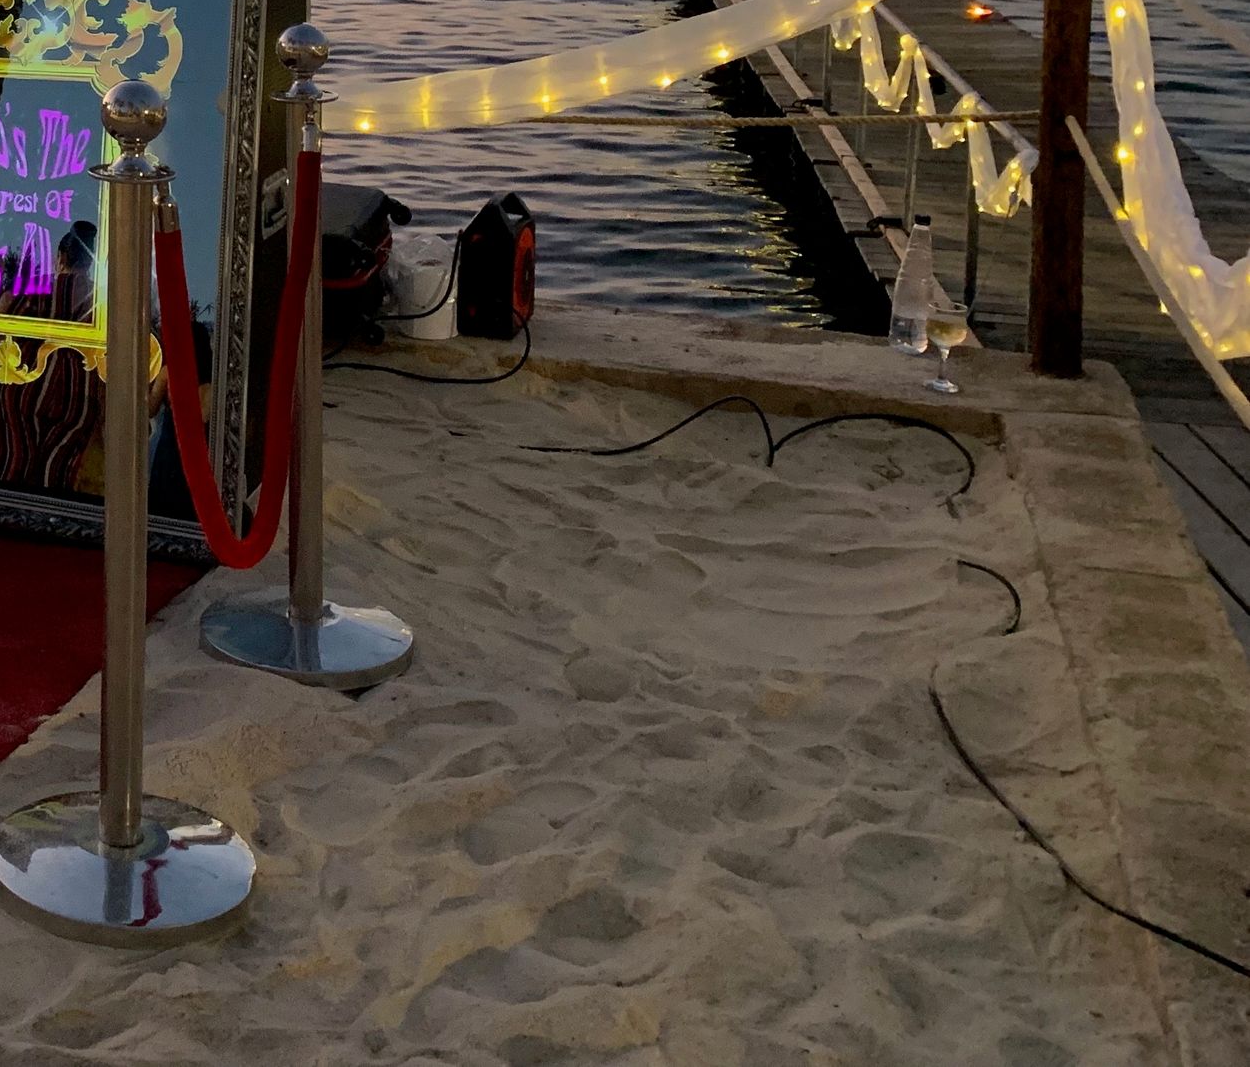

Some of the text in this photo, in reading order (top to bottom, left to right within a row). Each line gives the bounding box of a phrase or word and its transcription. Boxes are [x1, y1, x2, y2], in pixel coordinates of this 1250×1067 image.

[38, 109, 91, 180] The
[45, 190, 75, 222] Of
[13, 222, 53, 297] All
